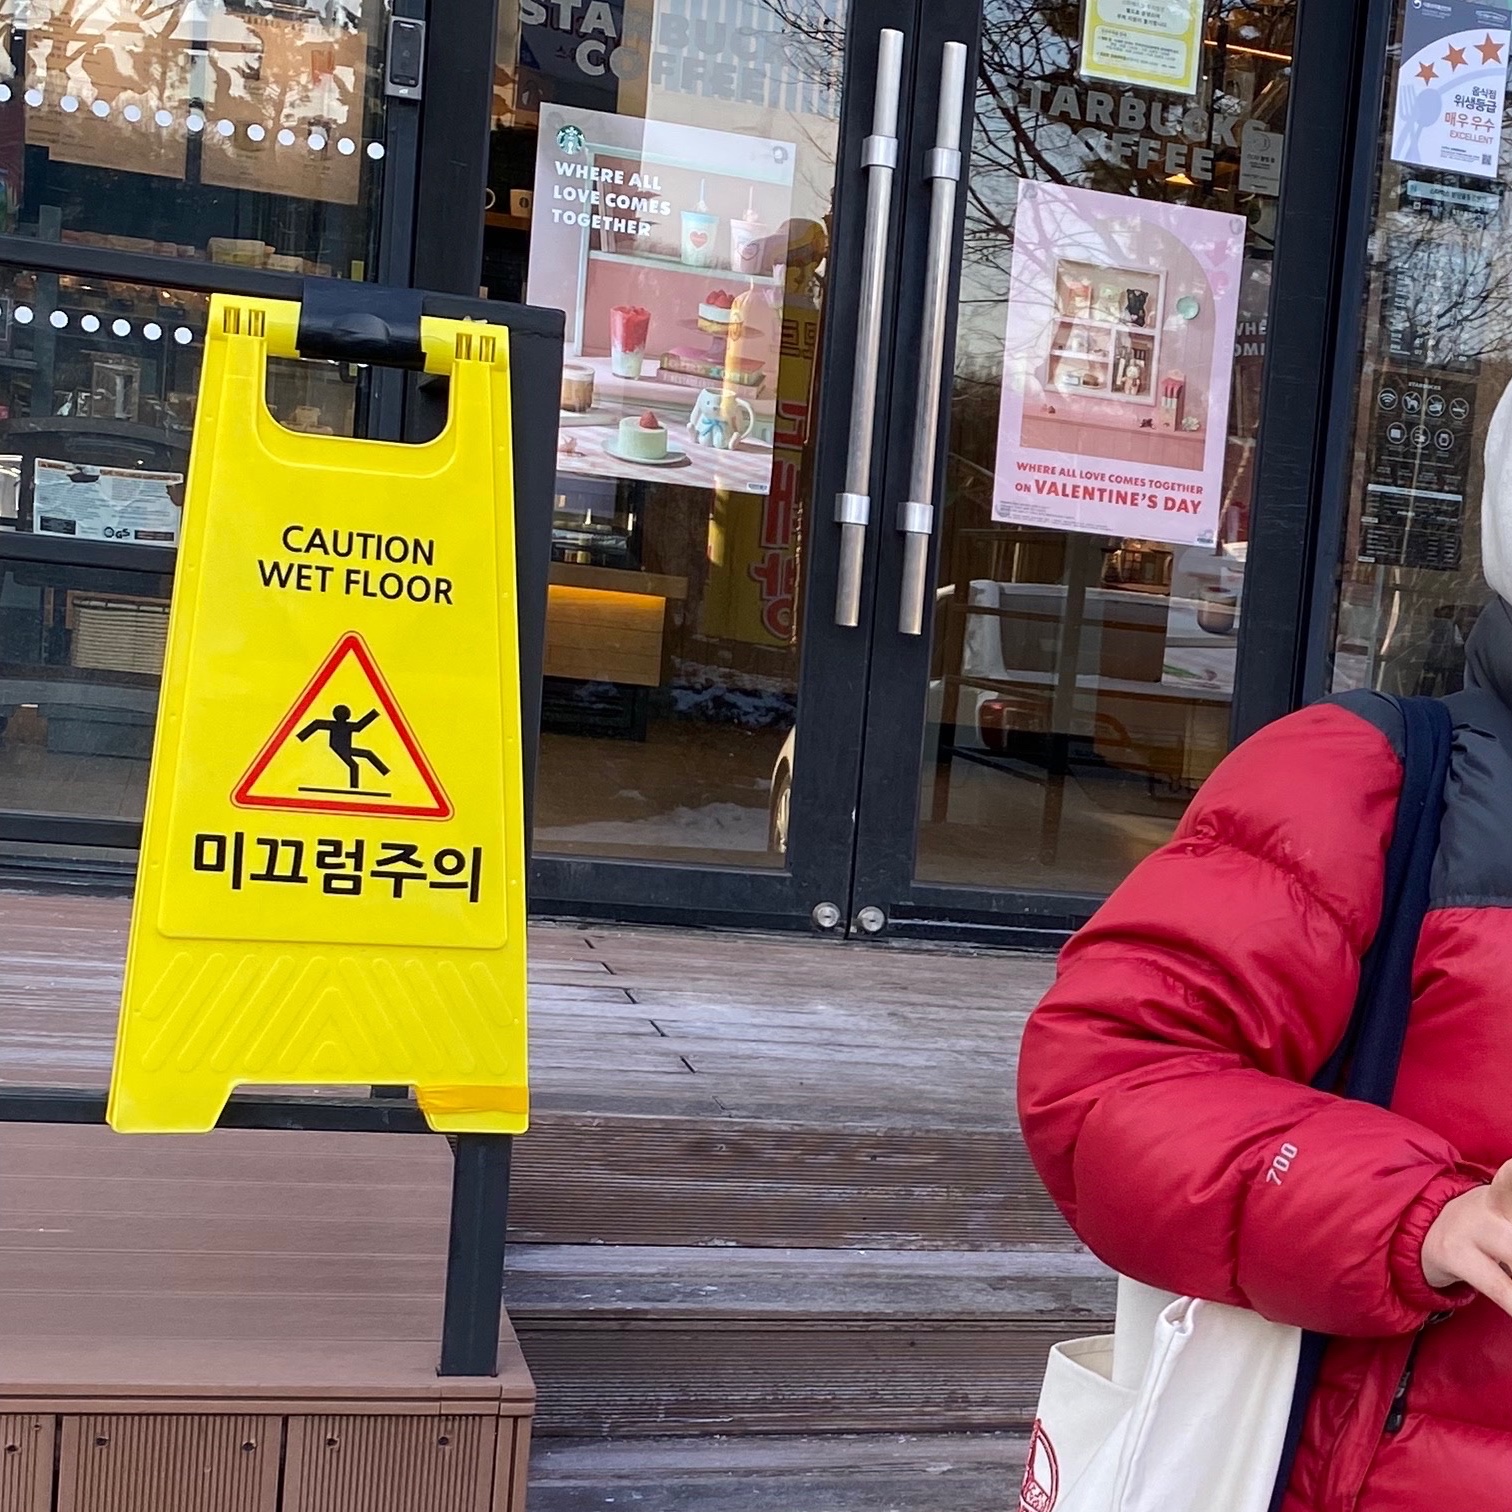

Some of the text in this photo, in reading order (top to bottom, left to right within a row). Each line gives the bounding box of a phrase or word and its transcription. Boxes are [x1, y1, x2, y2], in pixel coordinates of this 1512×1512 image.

[1454, 94, 1497, 114] 위생등급
[1472, 86, 1497, 99] 음식점
[1444, 111, 1495, 133] 매우 우수
[1449, 129, 1493, 145] EXCELLENT
[555, 160, 662, 191] WHERE ALL
[553, 185, 671, 216] LOVE COMES
[552, 209, 651, 236] TOGETHER
[1016, 461, 1204, 495] WHERE ALL LOVE COMES TOGETHER
[1015, 482, 1031, 493] ON
[1035, 479, 1158, 510] VALENTINE'S
[1163, 496, 1202, 515] DAY
[282, 524, 436, 566] CAUTION
[258, 559, 454, 605] WET FLOOR
[193, 831, 483, 903] 미끄럼주의
[1265, 1142, 1298, 1186] 700
